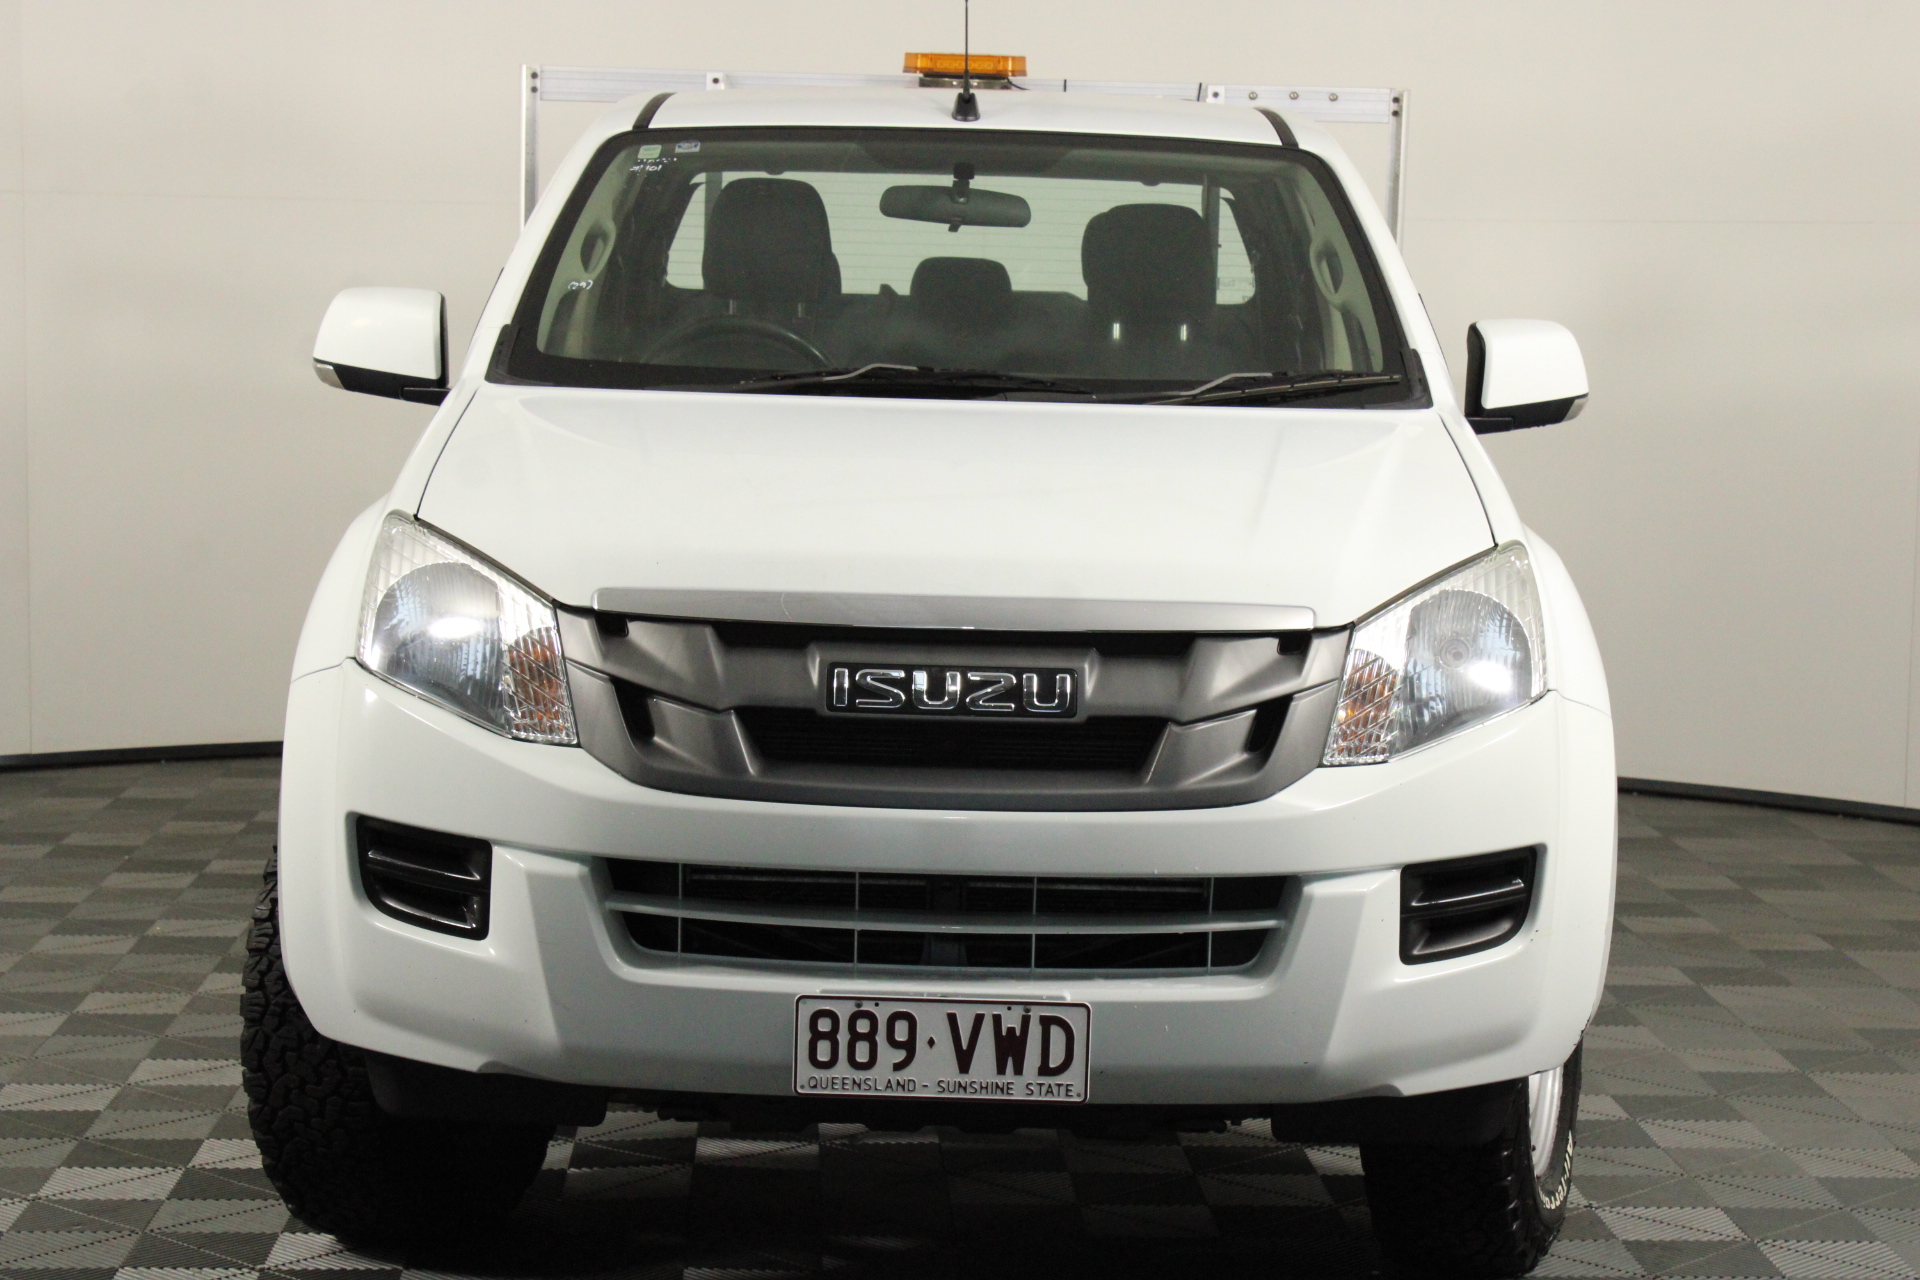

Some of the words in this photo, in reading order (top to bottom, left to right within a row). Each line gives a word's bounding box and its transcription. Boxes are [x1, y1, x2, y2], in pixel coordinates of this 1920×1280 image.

[833, 667, 1071, 713] ISUZU
[807, 1076, 917, 1093] QUEENSLAND
[936, 1080, 1015, 1096] SUNSHINE
[1025, 1082, 1075, 1098] STATE
